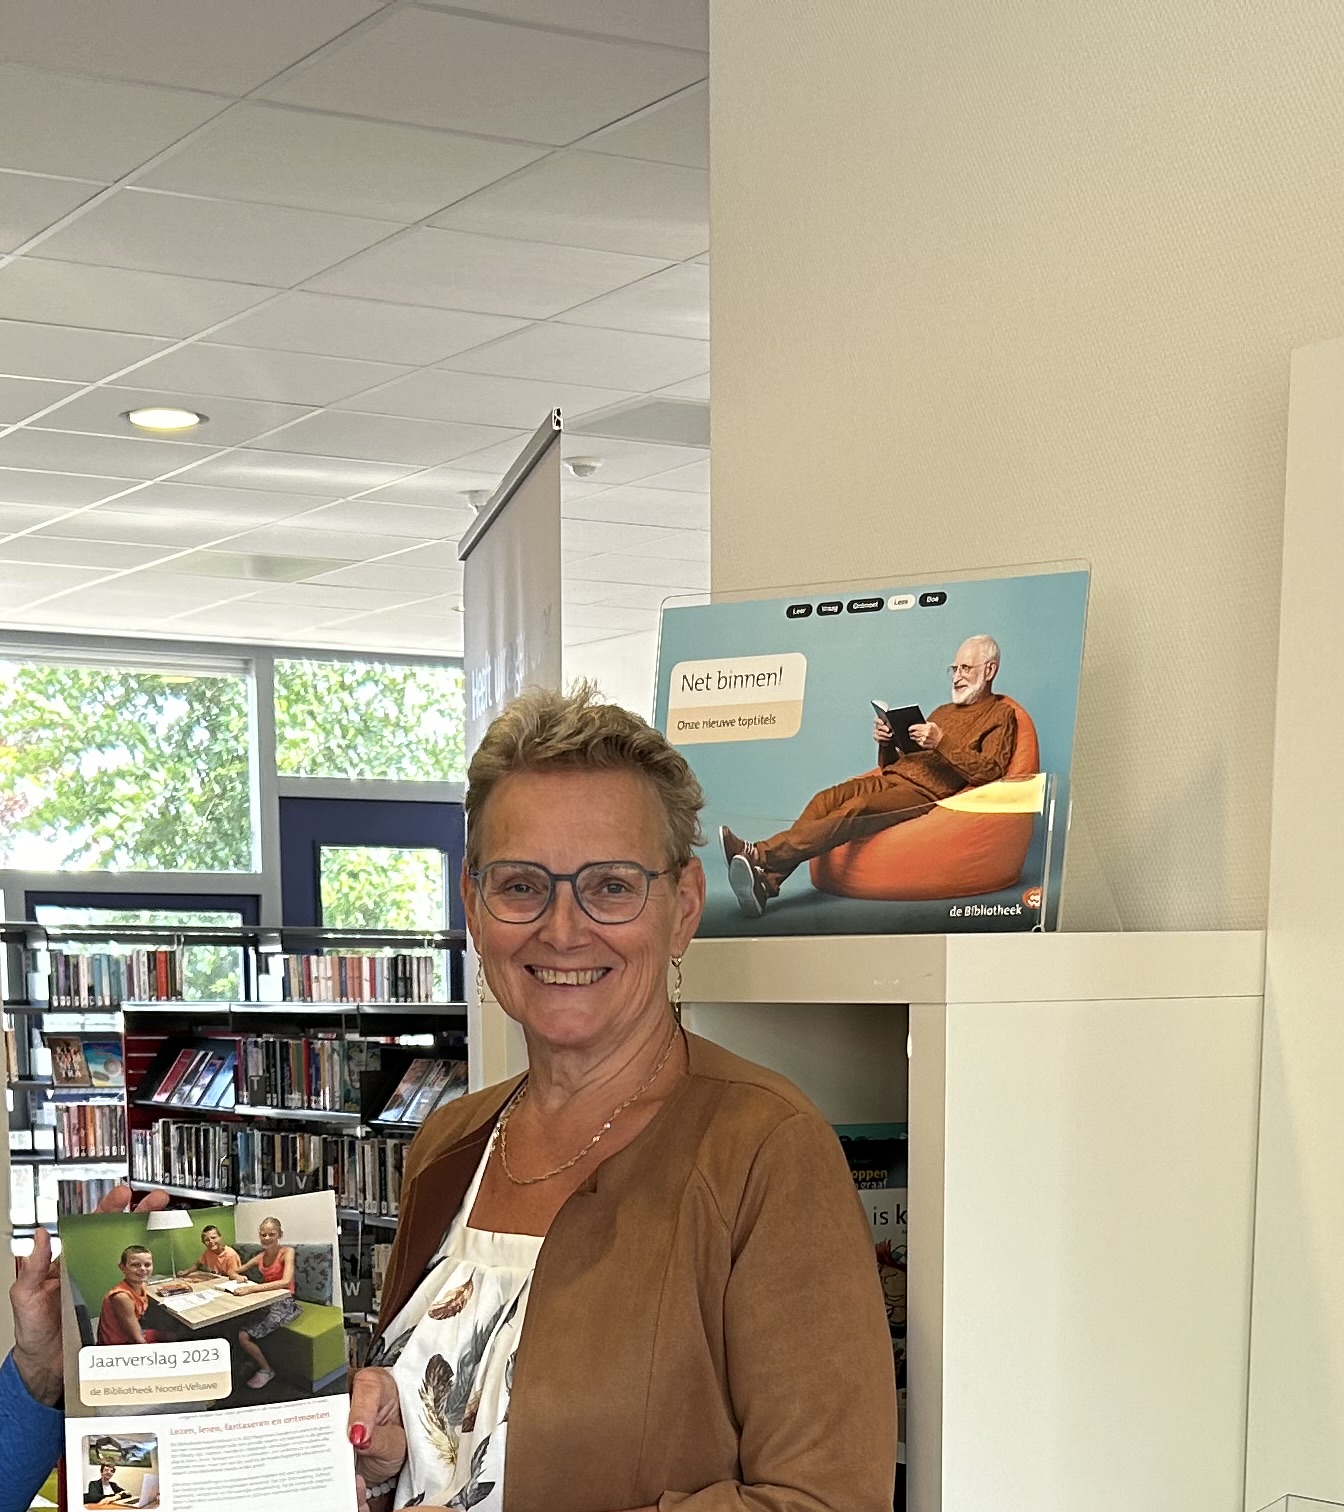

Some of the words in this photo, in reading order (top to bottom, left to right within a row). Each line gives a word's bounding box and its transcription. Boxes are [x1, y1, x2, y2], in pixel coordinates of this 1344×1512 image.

[682, 672, 712, 693] Net
[717, 665, 784, 690] binnen!
[677, 719, 700, 731] Onze
[702, 718, 736, 729] nieuwe
[738, 713, 776, 729] toptitels
[949, 905, 963, 917] de
[964, 903, 1023, 917] Bibliotheek
[251, 1076, 261, 1091] T
[274, 1173, 286, 1188] U
[295, 1175, 308, 1190] V
[873, 1205, 889, 1226] is
[343, 1281, 361, 1297] W
[89, 1351, 177, 1369] Jaarverslag
[182, 1348, 220, 1364] 2023
[90, 1387, 102, 1396] de
[104, 1385, 154, 1396] Bibliotheek
[156, 1382, 218, 1394] Noord-Veluwe
